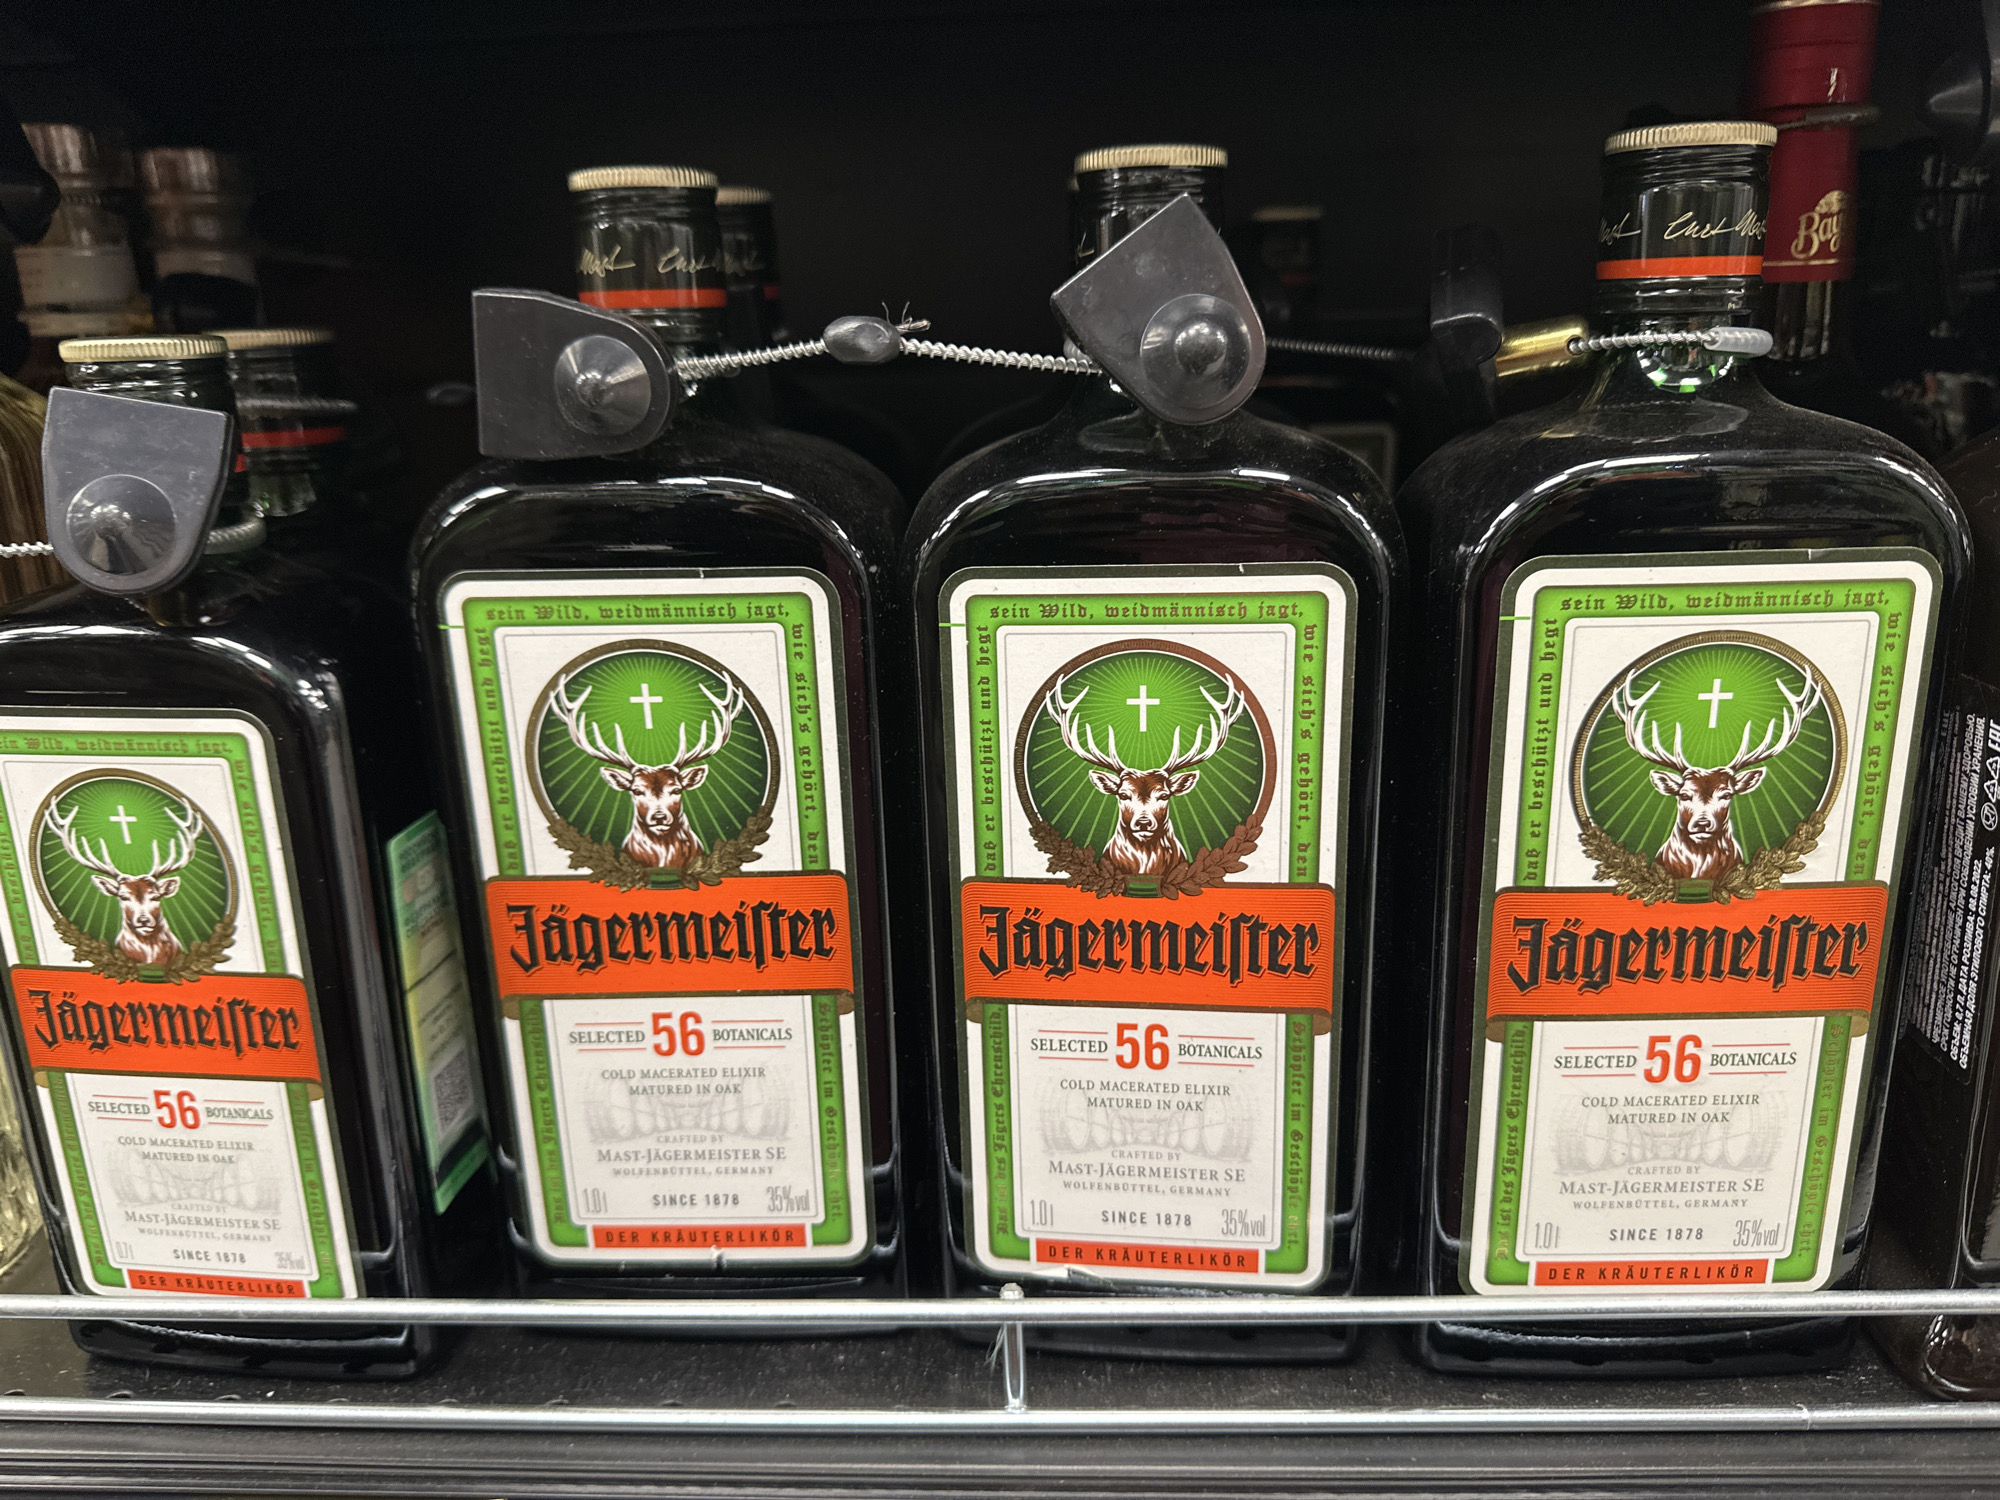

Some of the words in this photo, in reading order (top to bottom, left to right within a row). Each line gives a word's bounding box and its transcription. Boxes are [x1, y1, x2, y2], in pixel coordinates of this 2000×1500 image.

[505, 900, 837, 975] Jägermeister
[978, 904, 1319, 988] Jägermeister
[1507, 913, 1870, 995] Jägermeister
[27, 989, 300, 1058] Jägermeister
[568, 1029, 645, 1044] SELECTED
[649, 1010, 706, 1057] 56
[711, 1026, 793, 1043] BOTANICALS
[1030, 1038, 1108, 1053] SELECTED
[1115, 1022, 1169, 1071] 56
[1177, 1043, 1262, 1060] BOTANICALS
[1553, 1053, 1638, 1069] SELECTED
[1642, 1032, 1704, 1083] 56
[1709, 1050, 1798, 1067] BOTANICALS
[601, 1068, 635, 1080] COLD
[639, 1066, 718, 1080] MACERATED
[721, 1066, 767, 1079] ELIXIR
[629, 1083, 692, 1096] MATURED
[696, 1084, 711, 1094] IN
[715, 1083, 742, 1094] OAK
[1060, 1078, 1094, 1091] COLD
[1099, 1079, 1179, 1094] MACERATED
[1184, 1084, 1231, 1097] ELIXIR
[88, 1102, 151, 1116] SELECTED
[153, 1090, 200, 1129] 56
[205, 1107, 273, 1121] BOTANICALS
[1087, 1096, 1151, 1109] MATURED
[1156, 1099, 1171, 1110] IN
[1176, 1100, 1204, 1112] OAK
[1581, 1095, 1618, 1108] COLD
[1622, 1092, 1708, 1107] MACERATED
[1711, 1092, 1761, 1106] ELIXIR
[1607, 1111, 1676, 1124] MATURED
[1680, 1111, 1696, 1123] IN
[1700, 1110, 1731, 1123] OAK
[596, 1143, 763, 1165] MAST-JÄGERMEISTER
[768, 1145, 788, 1160] SE
[1111, 1149, 1163, 1161] CRAFTED
[1167, 1151, 1181, 1161] BY
[1048, 1158, 1219, 1182] MAST-JÄGERMEISTER
[1225, 1167, 1246, 1183] SE
[1627, 1164, 1682, 1176] CRAFTED
[1685, 1164, 1701, 1175] BY
[1062, 1178, 1165, 1195] WOLFENBÜTTEL,
[1170, 1185, 1231, 1197] GERMANY
[1558, 1175, 1739, 1198] MAST-JÄGERMEISTER
[1743, 1176, 1766, 1192] SE
[653, 1193, 699, 1207] SINCE
[706, 1192, 742, 1207] 1878
[1571, 1196, 1680, 1213] WOLFENBÜTTEL,
[1684, 1197, 1748, 1209] GERMANY
[1101, 1209, 1147, 1225] SINCE
[1156, 1212, 1192, 1228] 1878
[605, 1231, 641, 1245] DER
[651, 1225, 796, 1245] KRÄUTERLIKÖR
[1609, 1228, 1658, 1244] SINCE
[1666, 1227, 1705, 1243] 1878
[172, 1249, 211, 1262] SINCE
[216, 1251, 247, 1264] 1878
[1048, 1244, 1083, 1259] DER
[1096, 1245, 1246, 1268] KRÄUTERLIKÖR
[1548, 1267, 1588, 1281] DER
[1599, 1261, 1756, 1284] KRÄUTERLIKÖR
